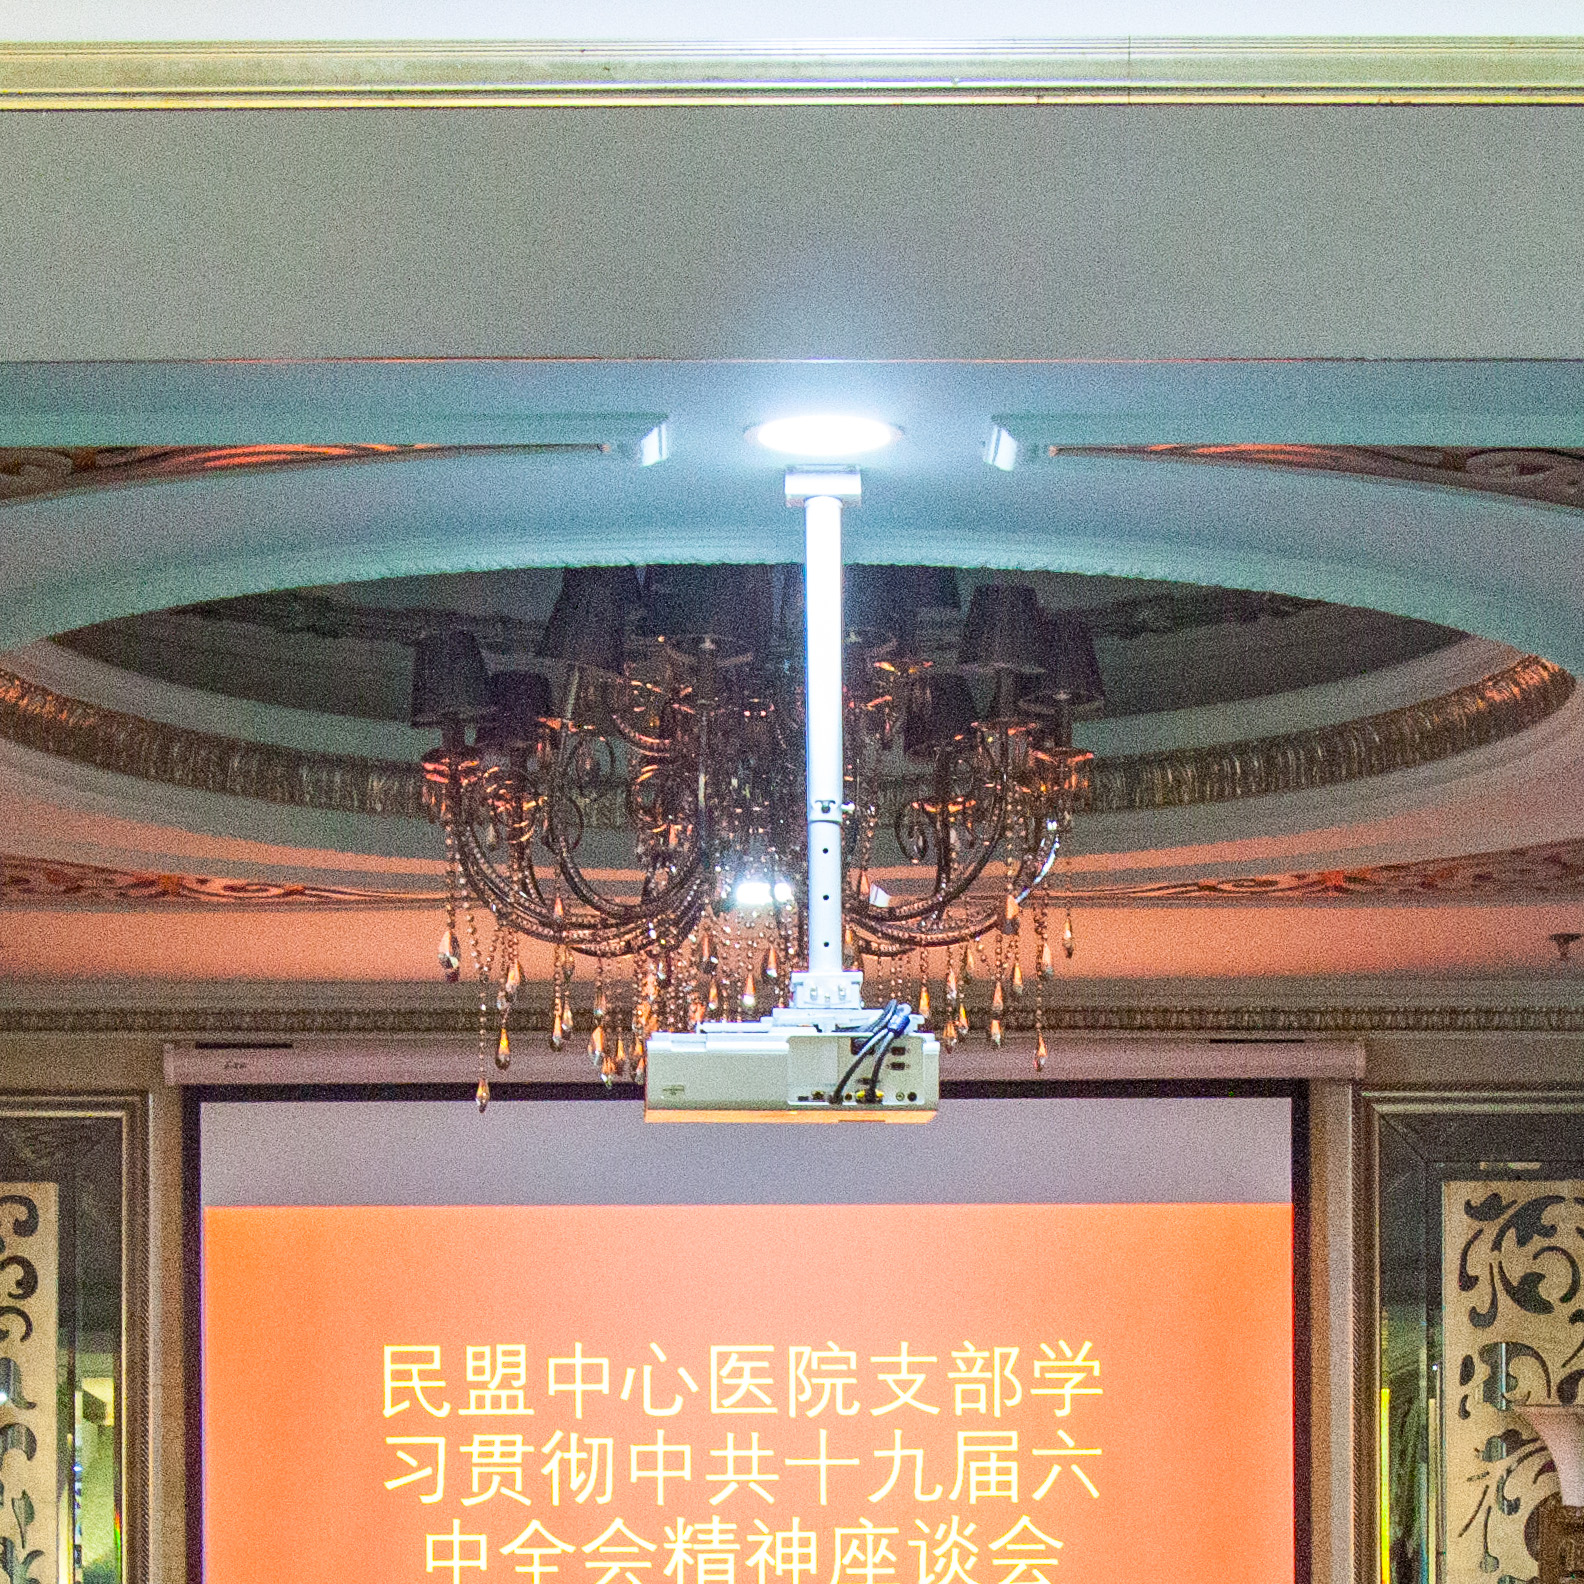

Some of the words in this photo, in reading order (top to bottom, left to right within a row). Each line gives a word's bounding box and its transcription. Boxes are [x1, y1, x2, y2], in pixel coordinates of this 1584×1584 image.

[380, 1340, 1105, 1420] 民盟中心医院支部学
[382, 1428, 1104, 1506] 习贯彻中共十九届六
